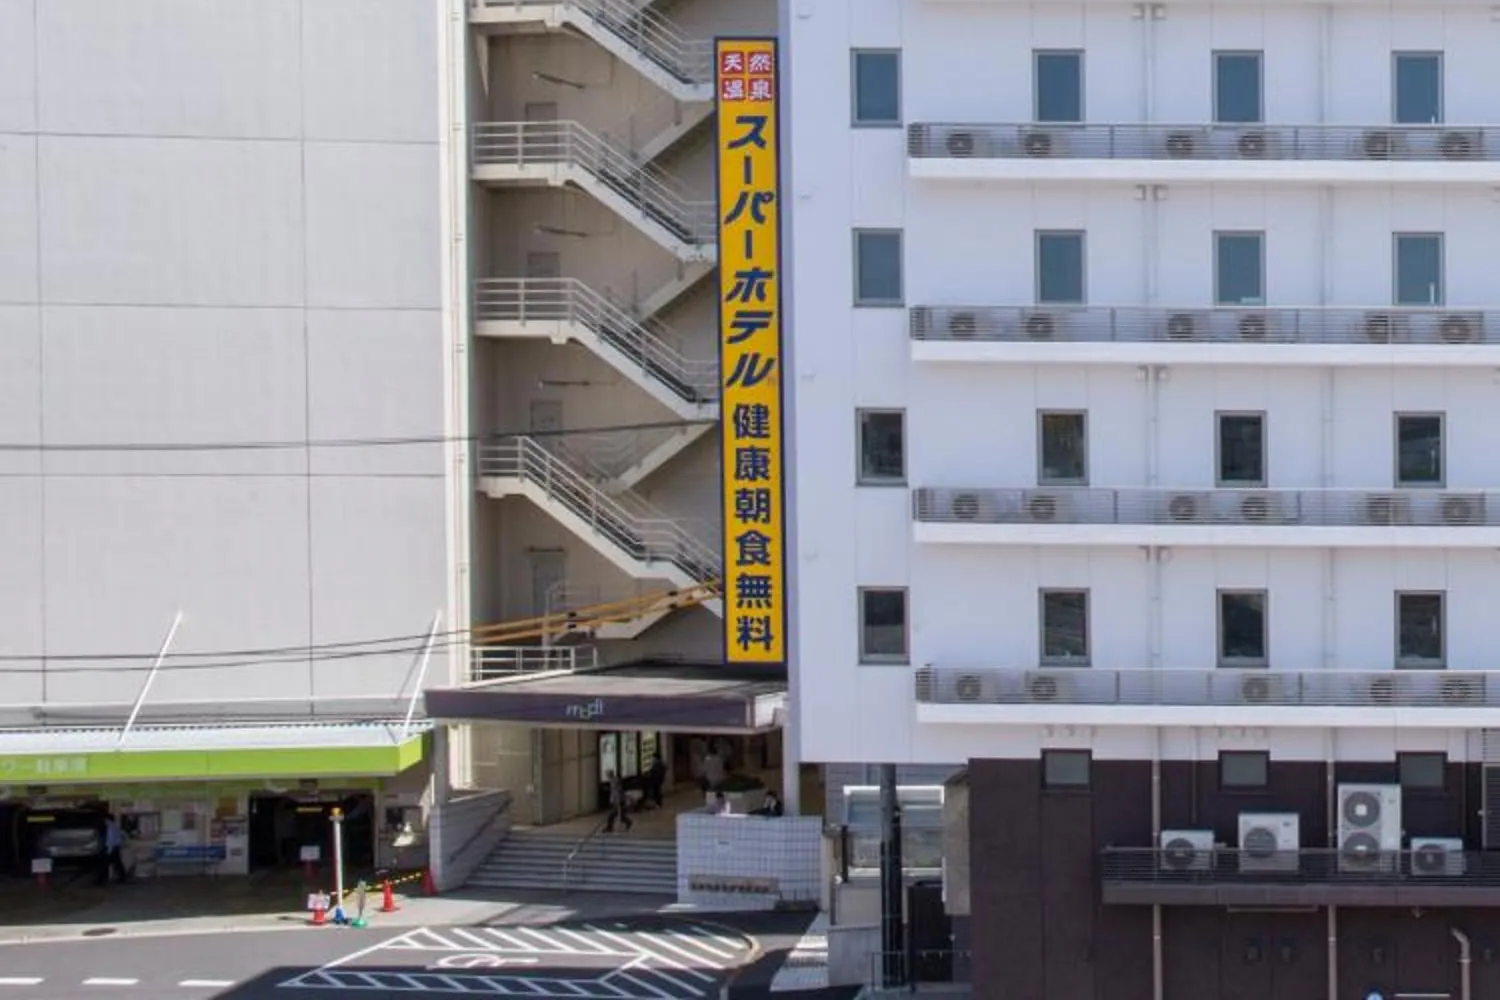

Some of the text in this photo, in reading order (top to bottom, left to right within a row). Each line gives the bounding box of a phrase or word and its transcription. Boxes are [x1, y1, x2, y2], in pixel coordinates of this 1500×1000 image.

[723, 52, 771, 72] 天然
[723, 79, 771, 100] 温泉
[724, 115, 776, 388] スーパーホテル
[731, 403, 775, 652] 健康朝食無料
